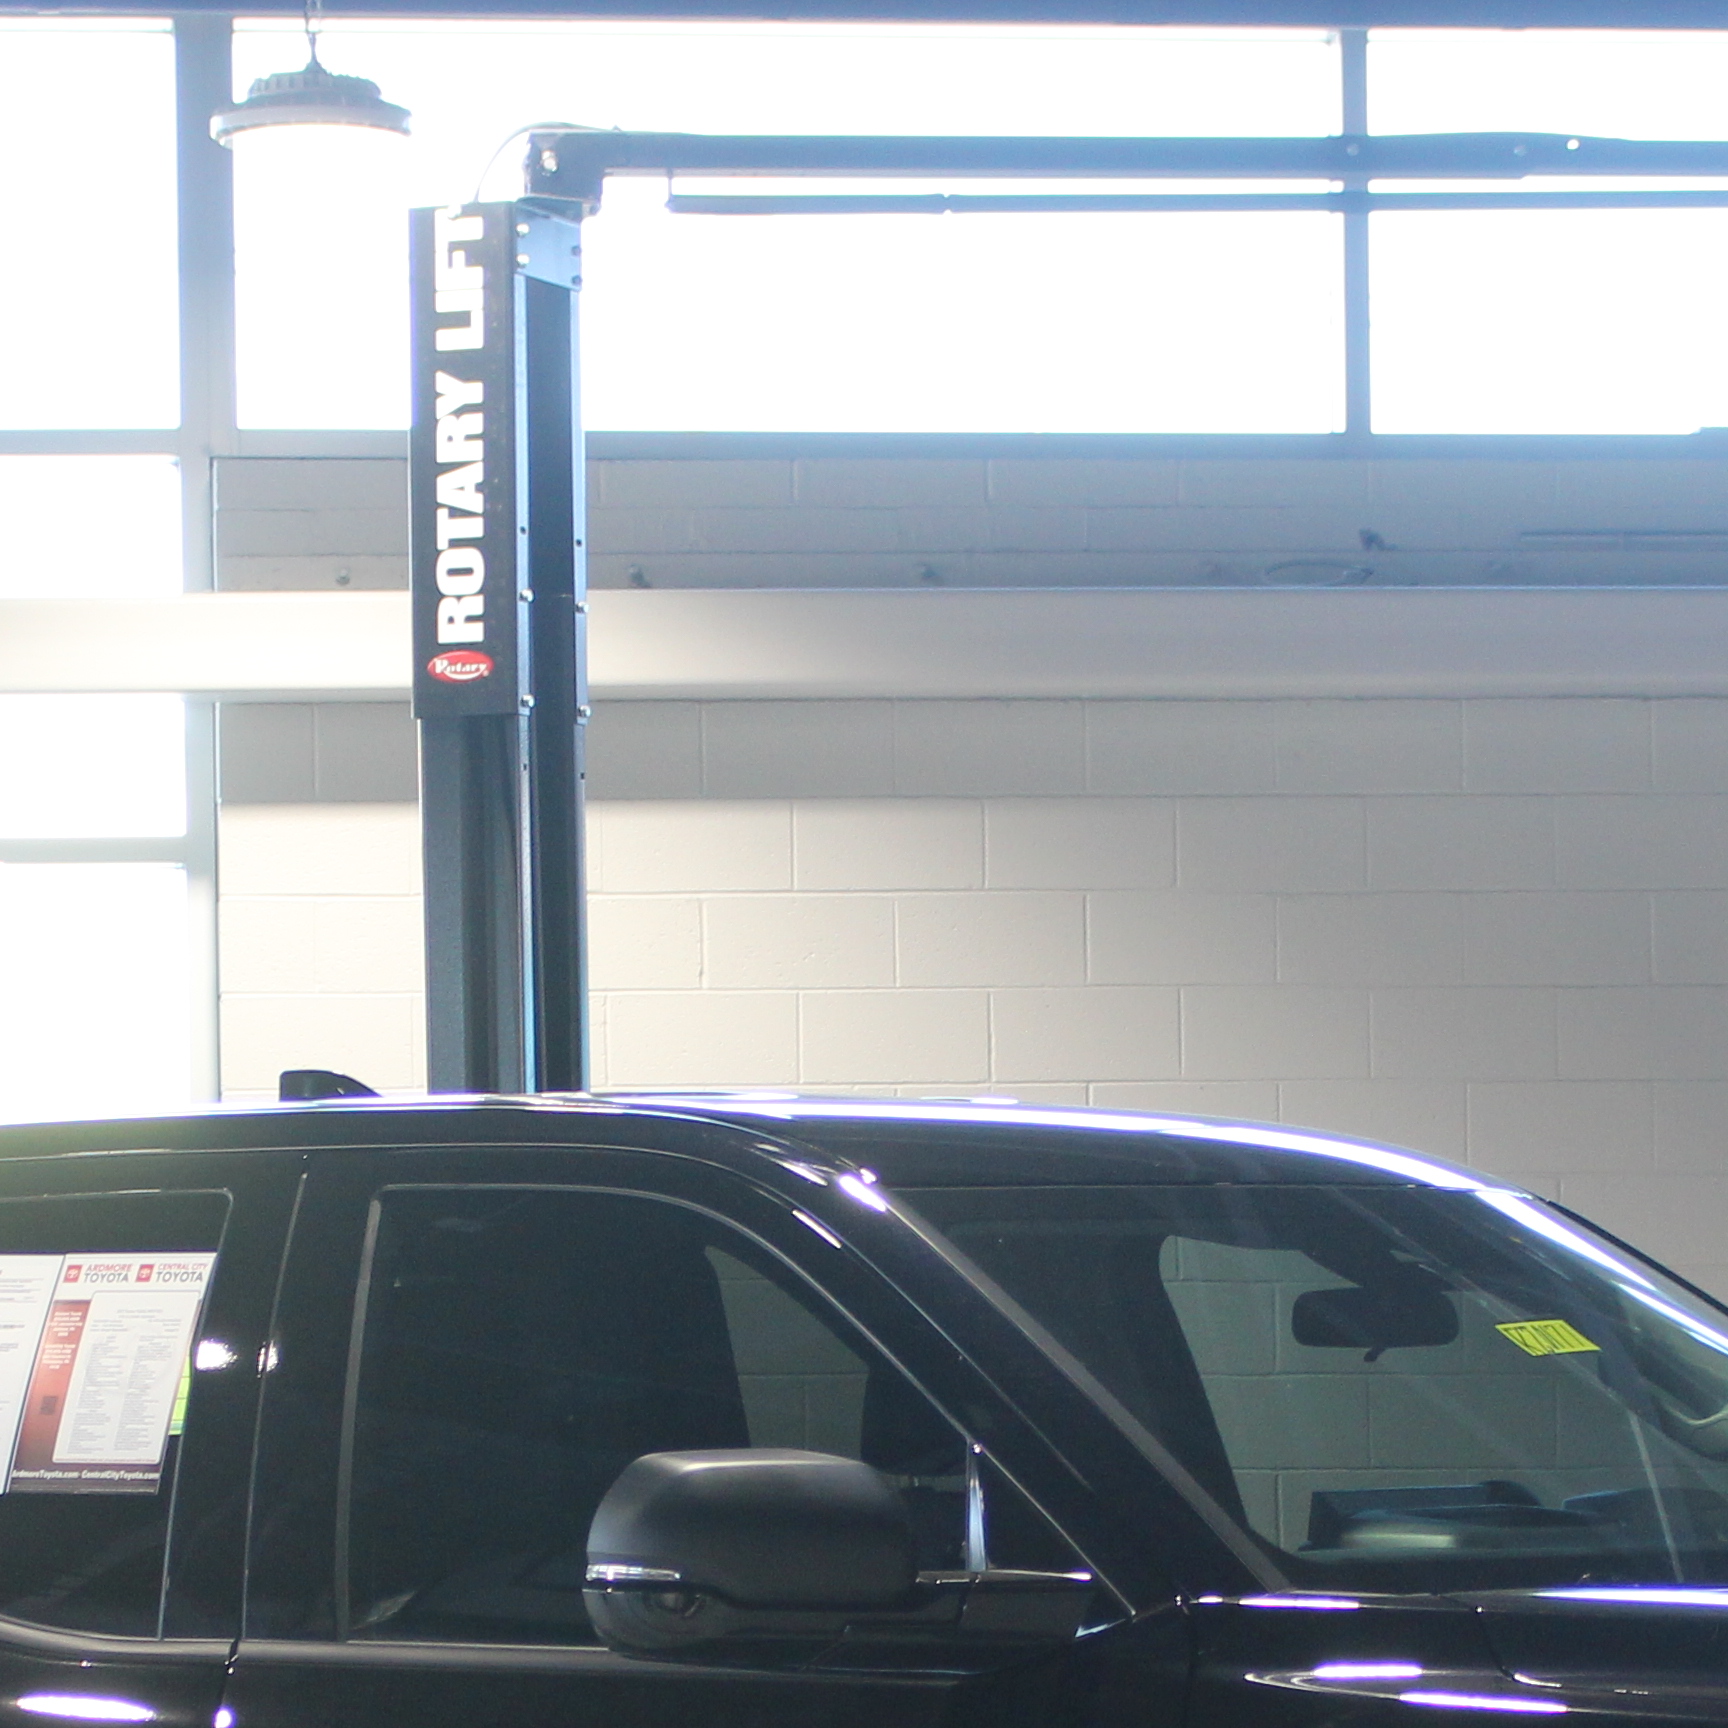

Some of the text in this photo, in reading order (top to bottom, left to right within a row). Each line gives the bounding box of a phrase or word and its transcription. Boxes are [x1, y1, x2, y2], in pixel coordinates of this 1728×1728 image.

[434, 207, 485, 646] ROTARY LIFT
[86, 1263, 133, 1272] ARDMORE
[83, 1272, 130, 1283] TOYOTA
[156, 1271, 204, 1283] TOYOTA
